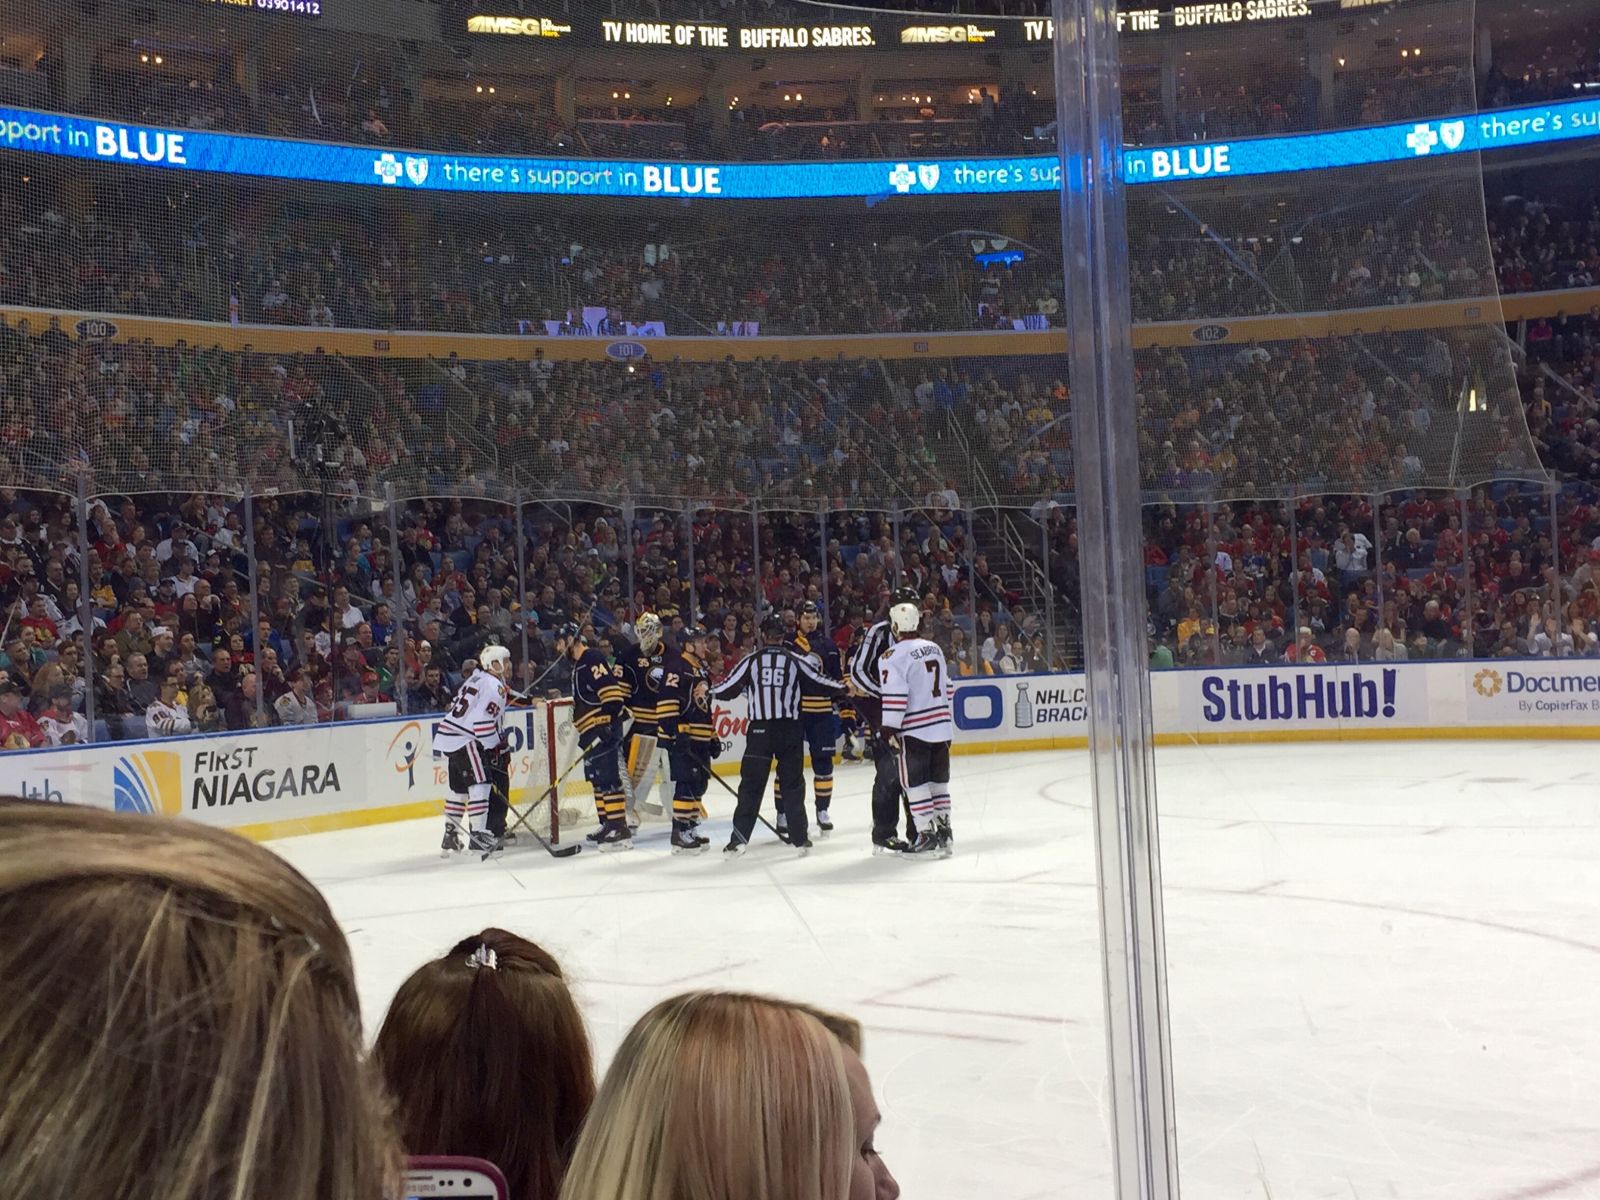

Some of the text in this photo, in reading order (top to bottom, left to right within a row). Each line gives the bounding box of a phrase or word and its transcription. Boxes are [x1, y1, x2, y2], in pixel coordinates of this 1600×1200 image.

[485, 16, 540, 35] MSG
[1130, 9, 1160, 31] THE
[1174, 1, 1242, 26] BUFFALO
[602, 22, 876, 48] TV HOME OF THE BUFFALO SABRES.
[918, 26, 966, 42] MSG
[1024, 20, 1044, 41] TV
[1481, 111, 1600, 138] there's su
[68, 125, 89, 147] in
[95, 125, 187, 165] BLUE
[953, 145, 1231, 187] there's sup in BLUE
[443, 160, 721, 194] there's support in BLUE
[86, 322, 107, 336] 100
[619, 345, 634, 356] 101
[591, 663, 609, 680] 24
[665, 672, 680, 688] 22
[761, 668, 785, 687] 96
[881, 670, 889, 684] 7
[925, 660, 942, 698] 7
[1507, 671, 1600, 693] Docume
[1035, 688, 1087, 705] NHL.C
[1202, 667, 1397, 722] StubHub!
[1519, 700, 1533, 713] By
[1535, 699, 1588, 712] CopierFax
[194, 746, 258, 773] FIRST
[191, 762, 341, 810] NIAGARA
[433, 766, 447, 785] Te
